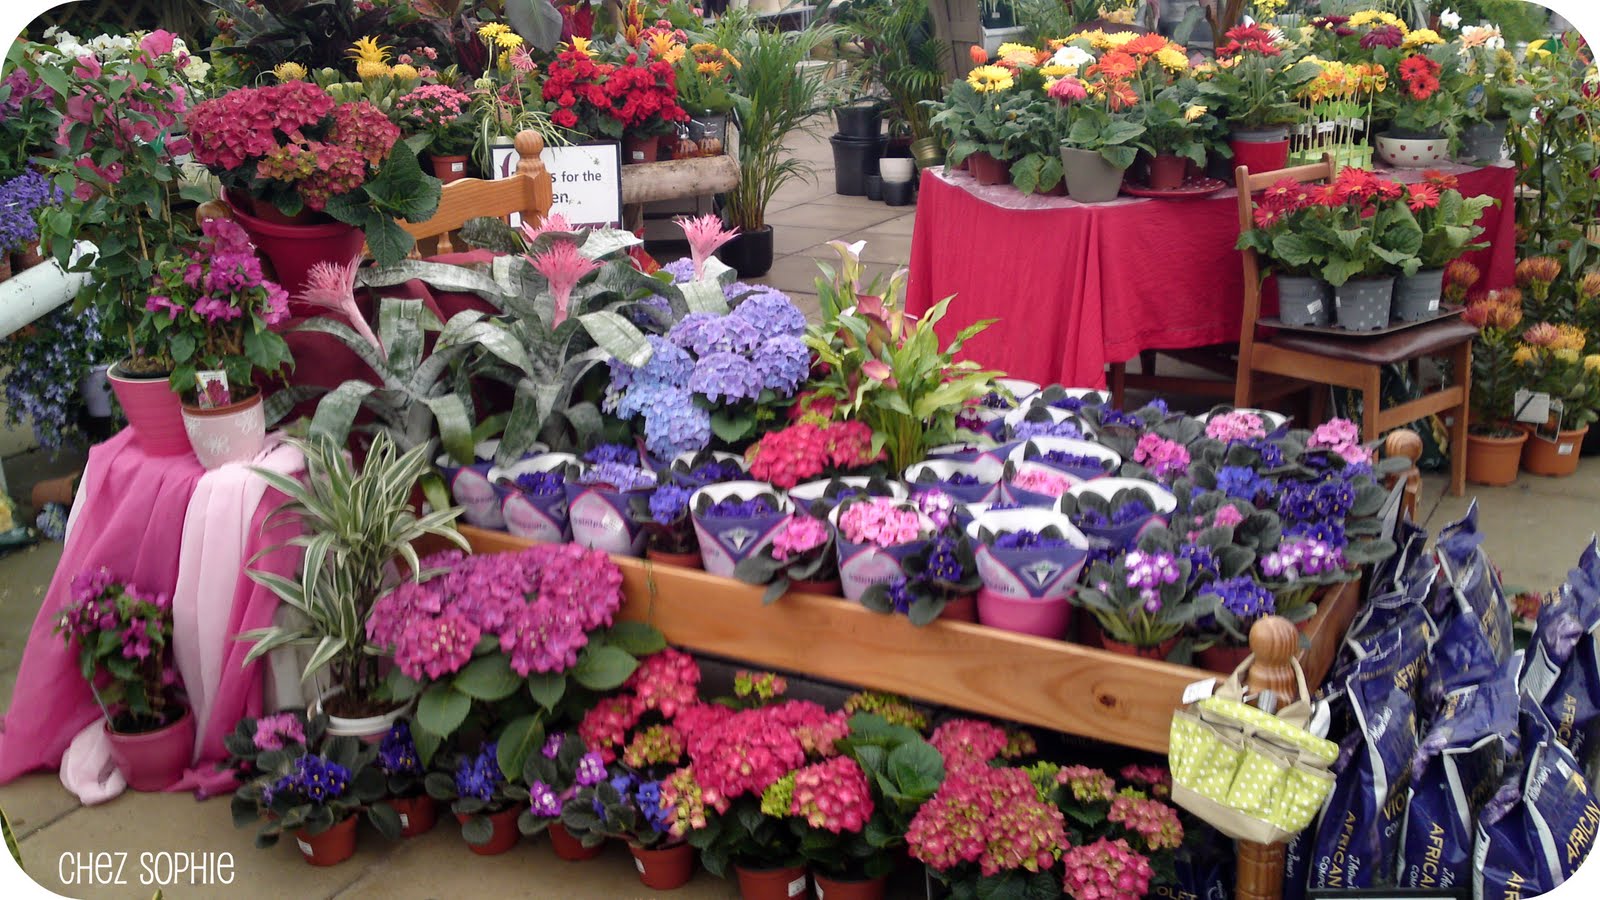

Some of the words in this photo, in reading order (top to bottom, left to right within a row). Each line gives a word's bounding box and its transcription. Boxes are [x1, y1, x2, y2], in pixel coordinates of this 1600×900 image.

[562, 171, 579, 183] for
[583, 169, 602, 182] the
[1328, 810, 1356, 887] AFRICAN
[1565, 799, 1600, 864] AFRICAN
[1317, 855, 1331, 889] COMPO
